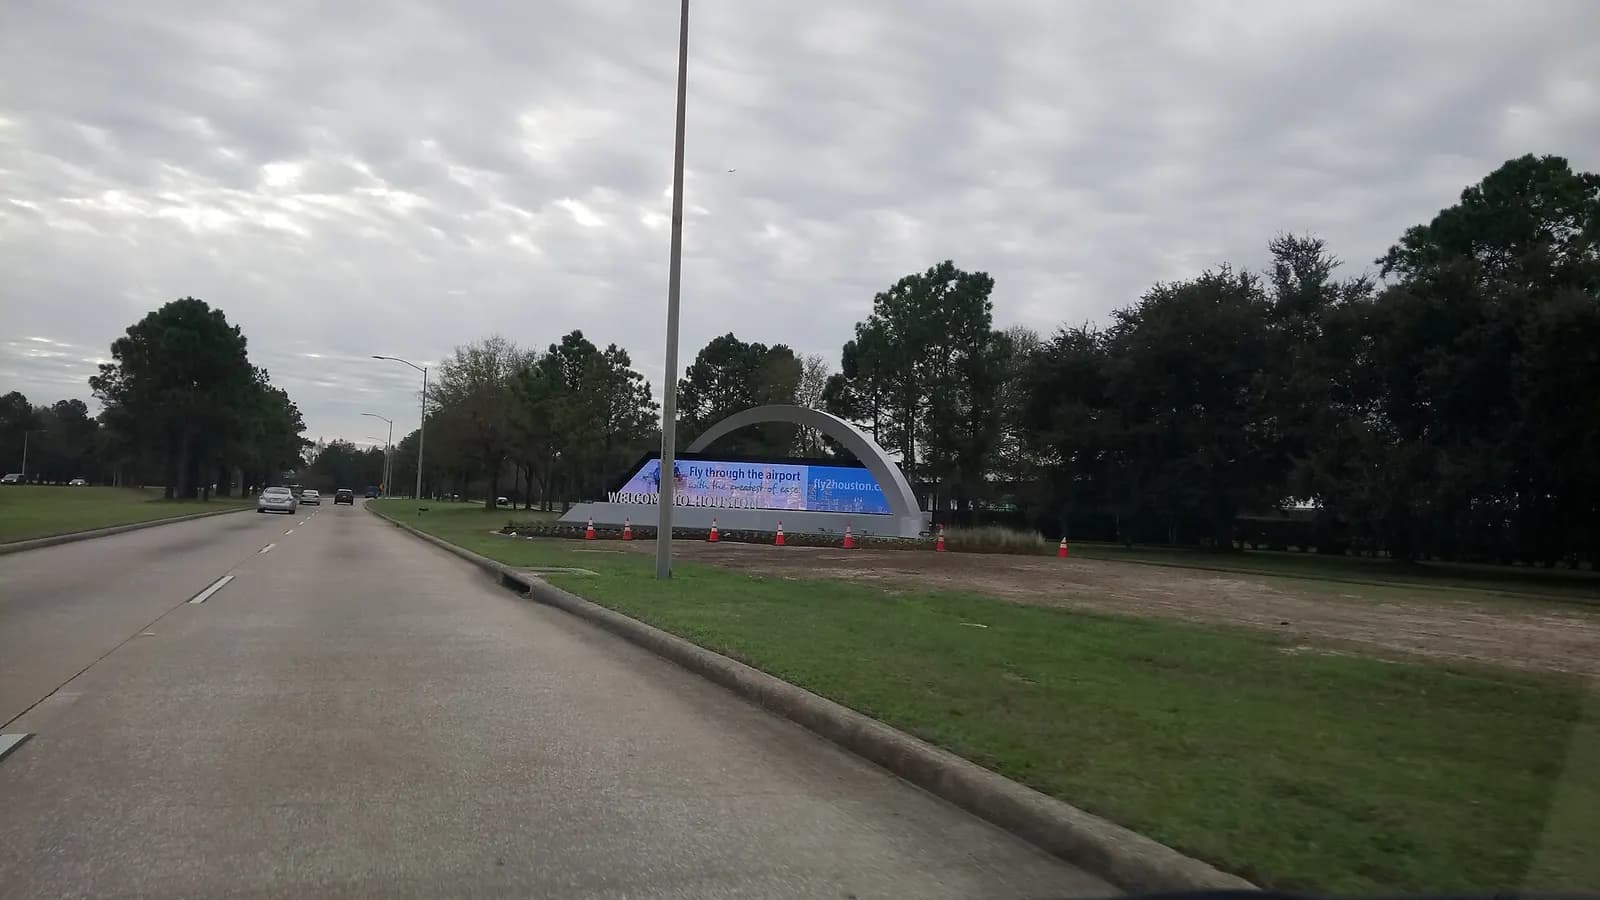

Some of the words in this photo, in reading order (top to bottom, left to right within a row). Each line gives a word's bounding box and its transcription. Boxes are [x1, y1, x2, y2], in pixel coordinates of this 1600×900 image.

[689, 466, 703, 479] Fly
[705, 467, 745, 481] through
[747, 469, 764, 480] the
[765, 470, 801, 482] airport
[688, 481, 709, 489] with
[712, 480, 729, 490] the
[767, 482, 777, 495] of
[813, 478, 882, 493] fly2houston.c
[608, 491, 661, 505] WELCOM
[694, 495, 758, 510] HOUSTON
